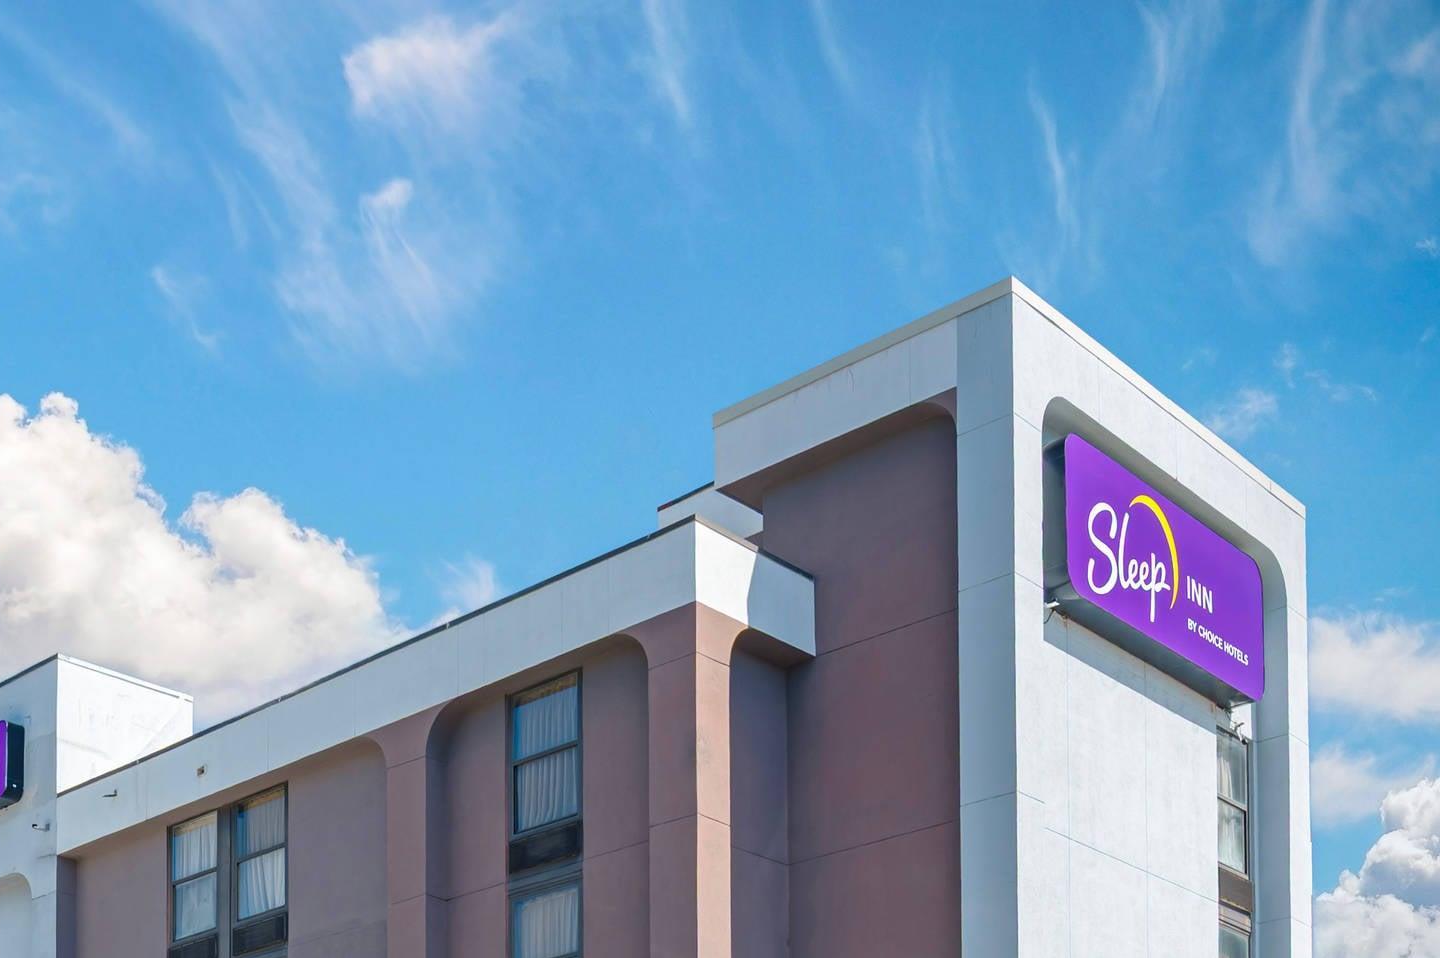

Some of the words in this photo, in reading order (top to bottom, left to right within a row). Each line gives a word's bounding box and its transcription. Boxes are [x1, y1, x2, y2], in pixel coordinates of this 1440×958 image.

[1087, 502, 1170, 622] Sleep
[1186, 575, 1213, 614] INN
[1187, 617, 1197, 633] BY
[1198, 625, 1223, 650] CHOICE
[1223, 641, 1249, 666] HOTELS
